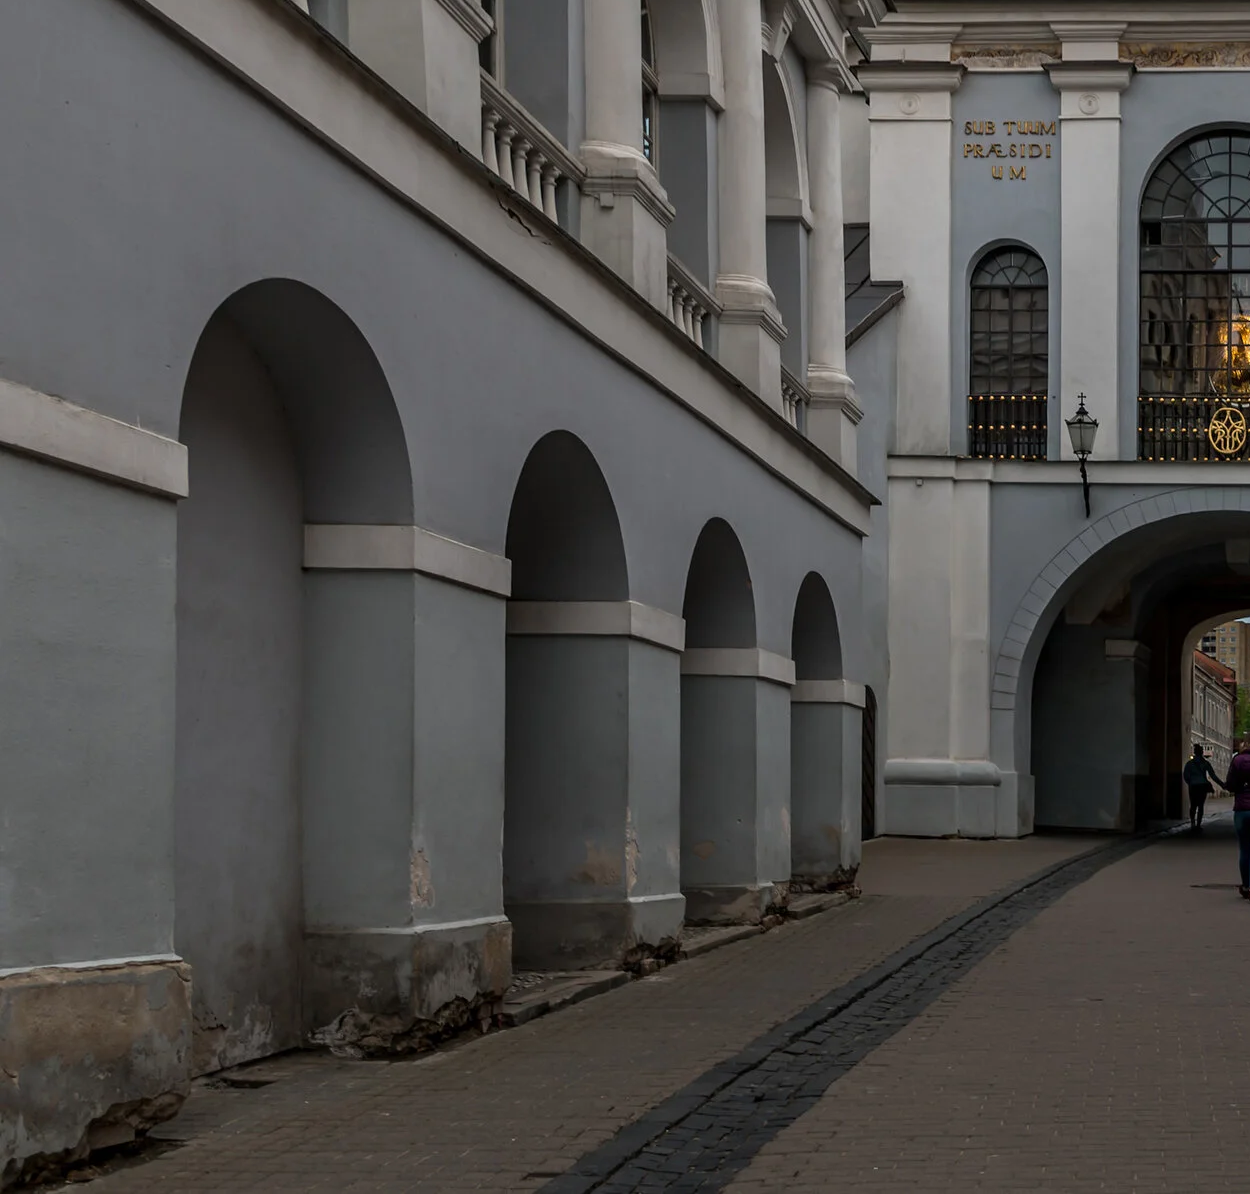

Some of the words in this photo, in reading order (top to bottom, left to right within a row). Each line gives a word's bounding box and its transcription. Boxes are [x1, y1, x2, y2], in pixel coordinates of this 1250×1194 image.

[964, 121, 996, 136] SUB
[1003, 121, 1056, 136] TUUM
[963, 143, 1052, 158] PRÆSIDI
[991, 165, 1027, 181] UM
